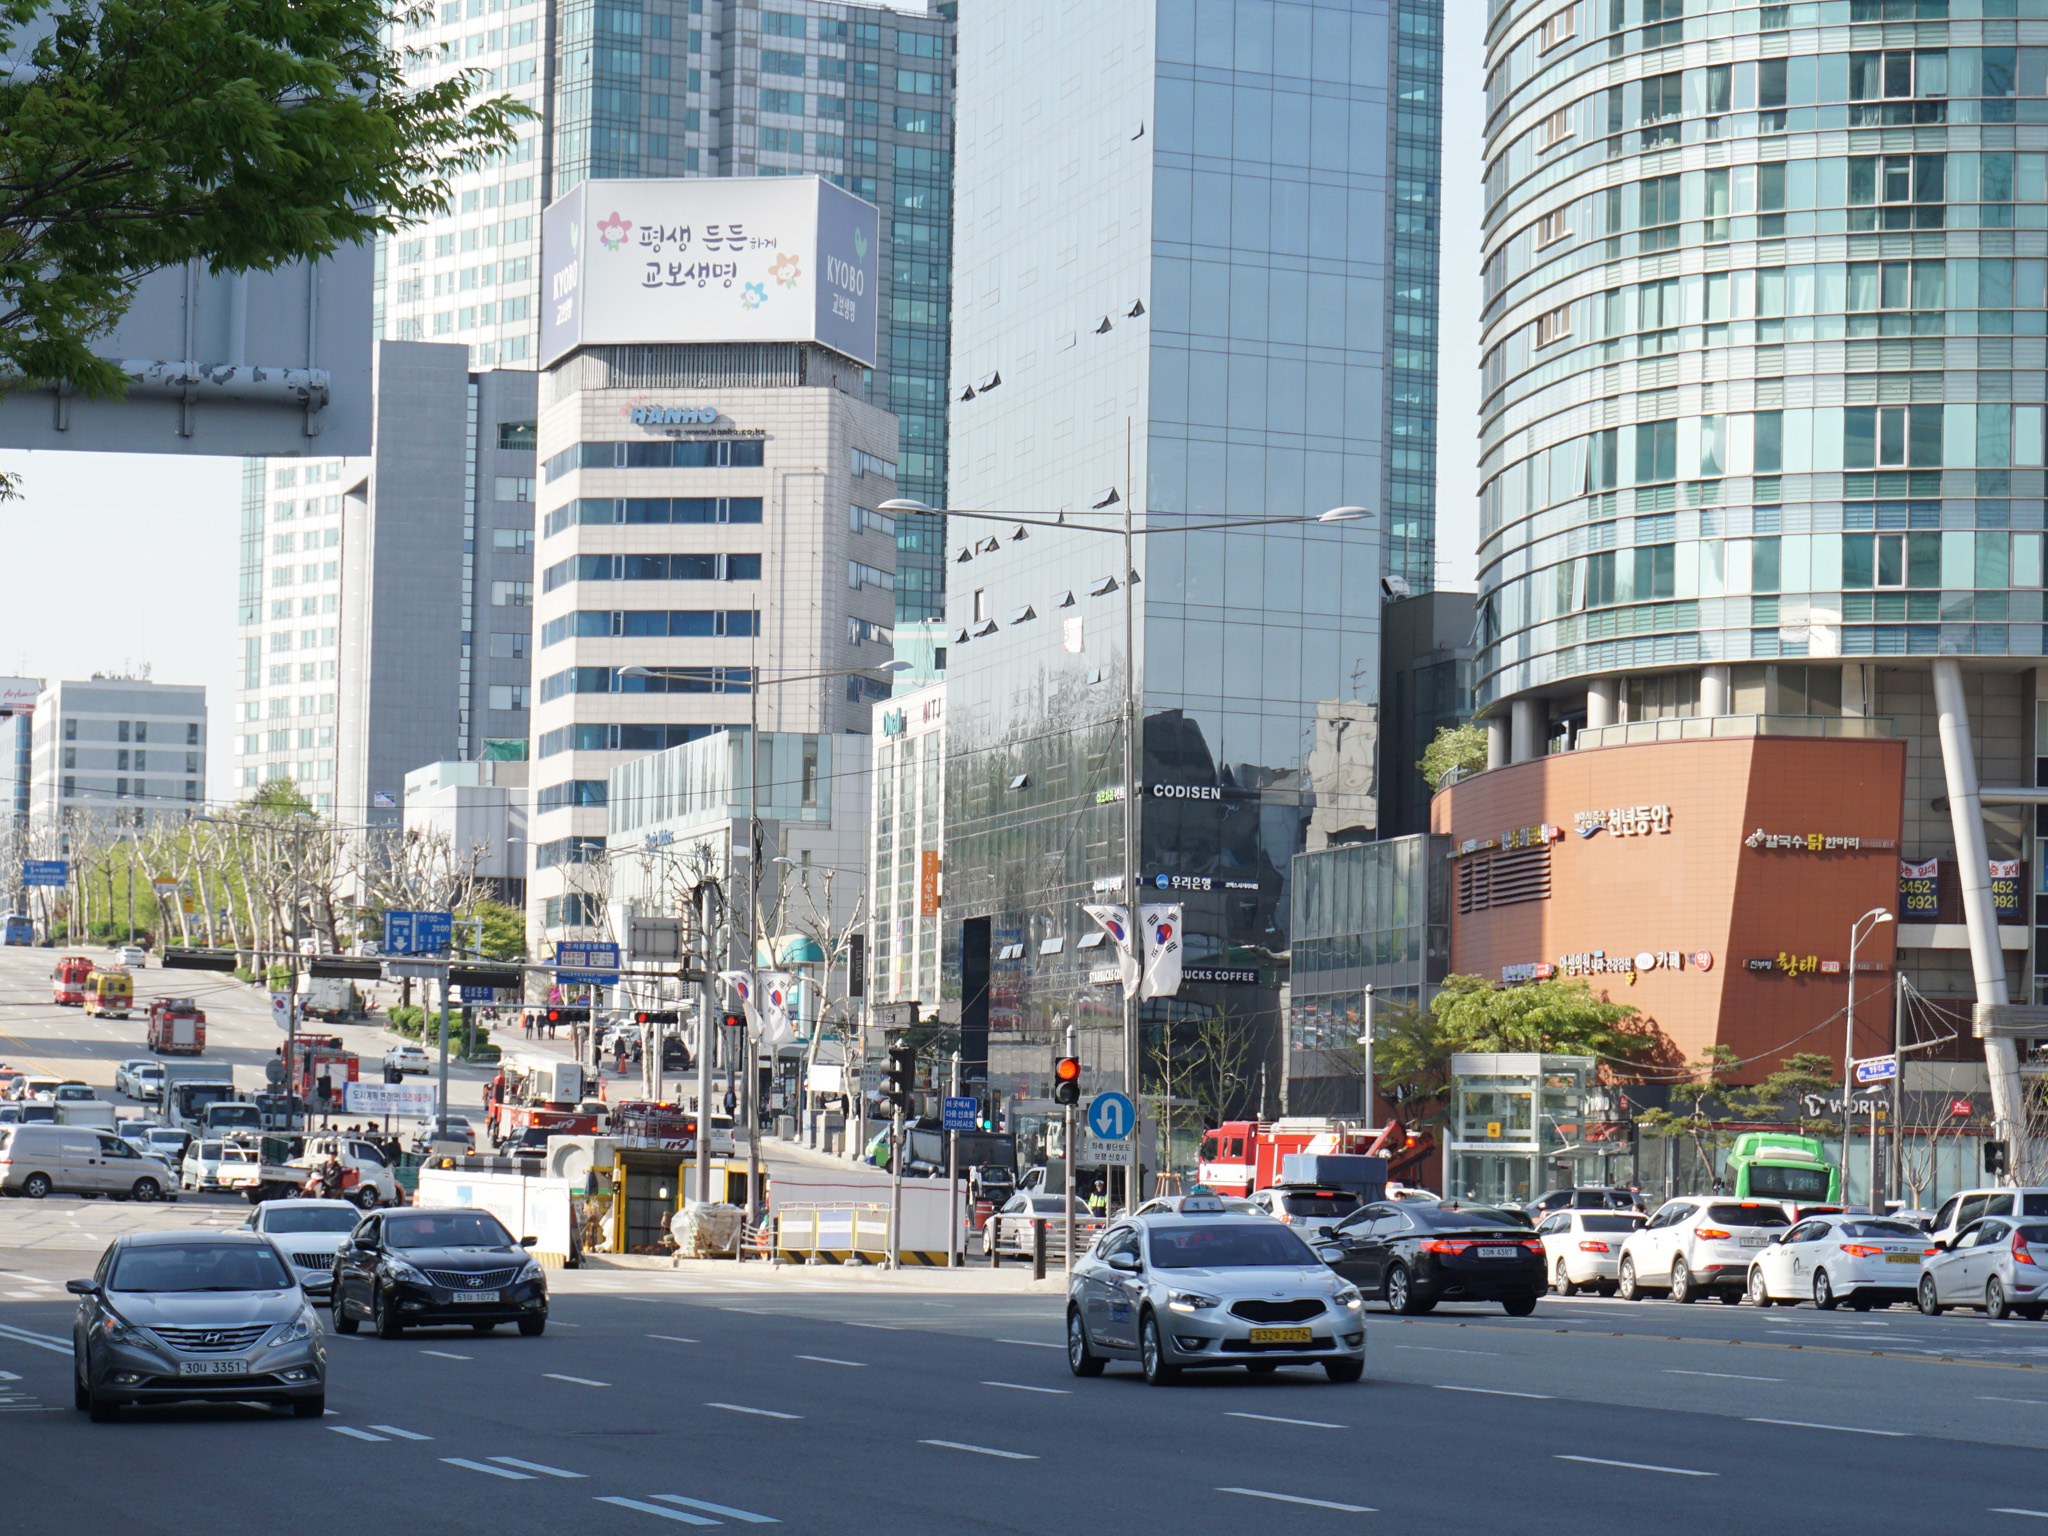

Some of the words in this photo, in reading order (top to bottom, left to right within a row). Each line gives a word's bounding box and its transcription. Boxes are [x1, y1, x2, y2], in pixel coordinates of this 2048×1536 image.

[639, 224, 691, 253] 평생
[552, 260, 579, 301] KYOBO
[641, 261, 737, 288] 교보생명
[826, 254, 865, 297] KYOBO
[629, 406, 718, 425] HANHO
[1153, 783, 1221, 800] CODISEN
[1607, 804, 1671, 836] 천년동안
[1918, 864, 1936, 875] 임대
[1171, 875, 1212, 891] 우리은행
[1992, 881, 2017, 894] 452-
[1907, 895, 1937, 909] 9921
[1656, 951, 1681, 969] 카페
[1696, 952, 1709, 967] 약
[1776, 952, 1818, 977] 황태
[1214, 971, 1255, 982] COFFEE
[945, 1110, 957, 1119] 다음
[945, 1120, 974, 1128] 기다리시오
[1878, 1126, 1886, 1135] 6
[664, 1138, 690, 1149] 119
[1108, 1153, 1127, 1161] 신호시
[475, 1292, 496, 1300] 1072
[1282, 1330, 1308, 1341] 2276
[212, 1361, 241, 1374] 3351
